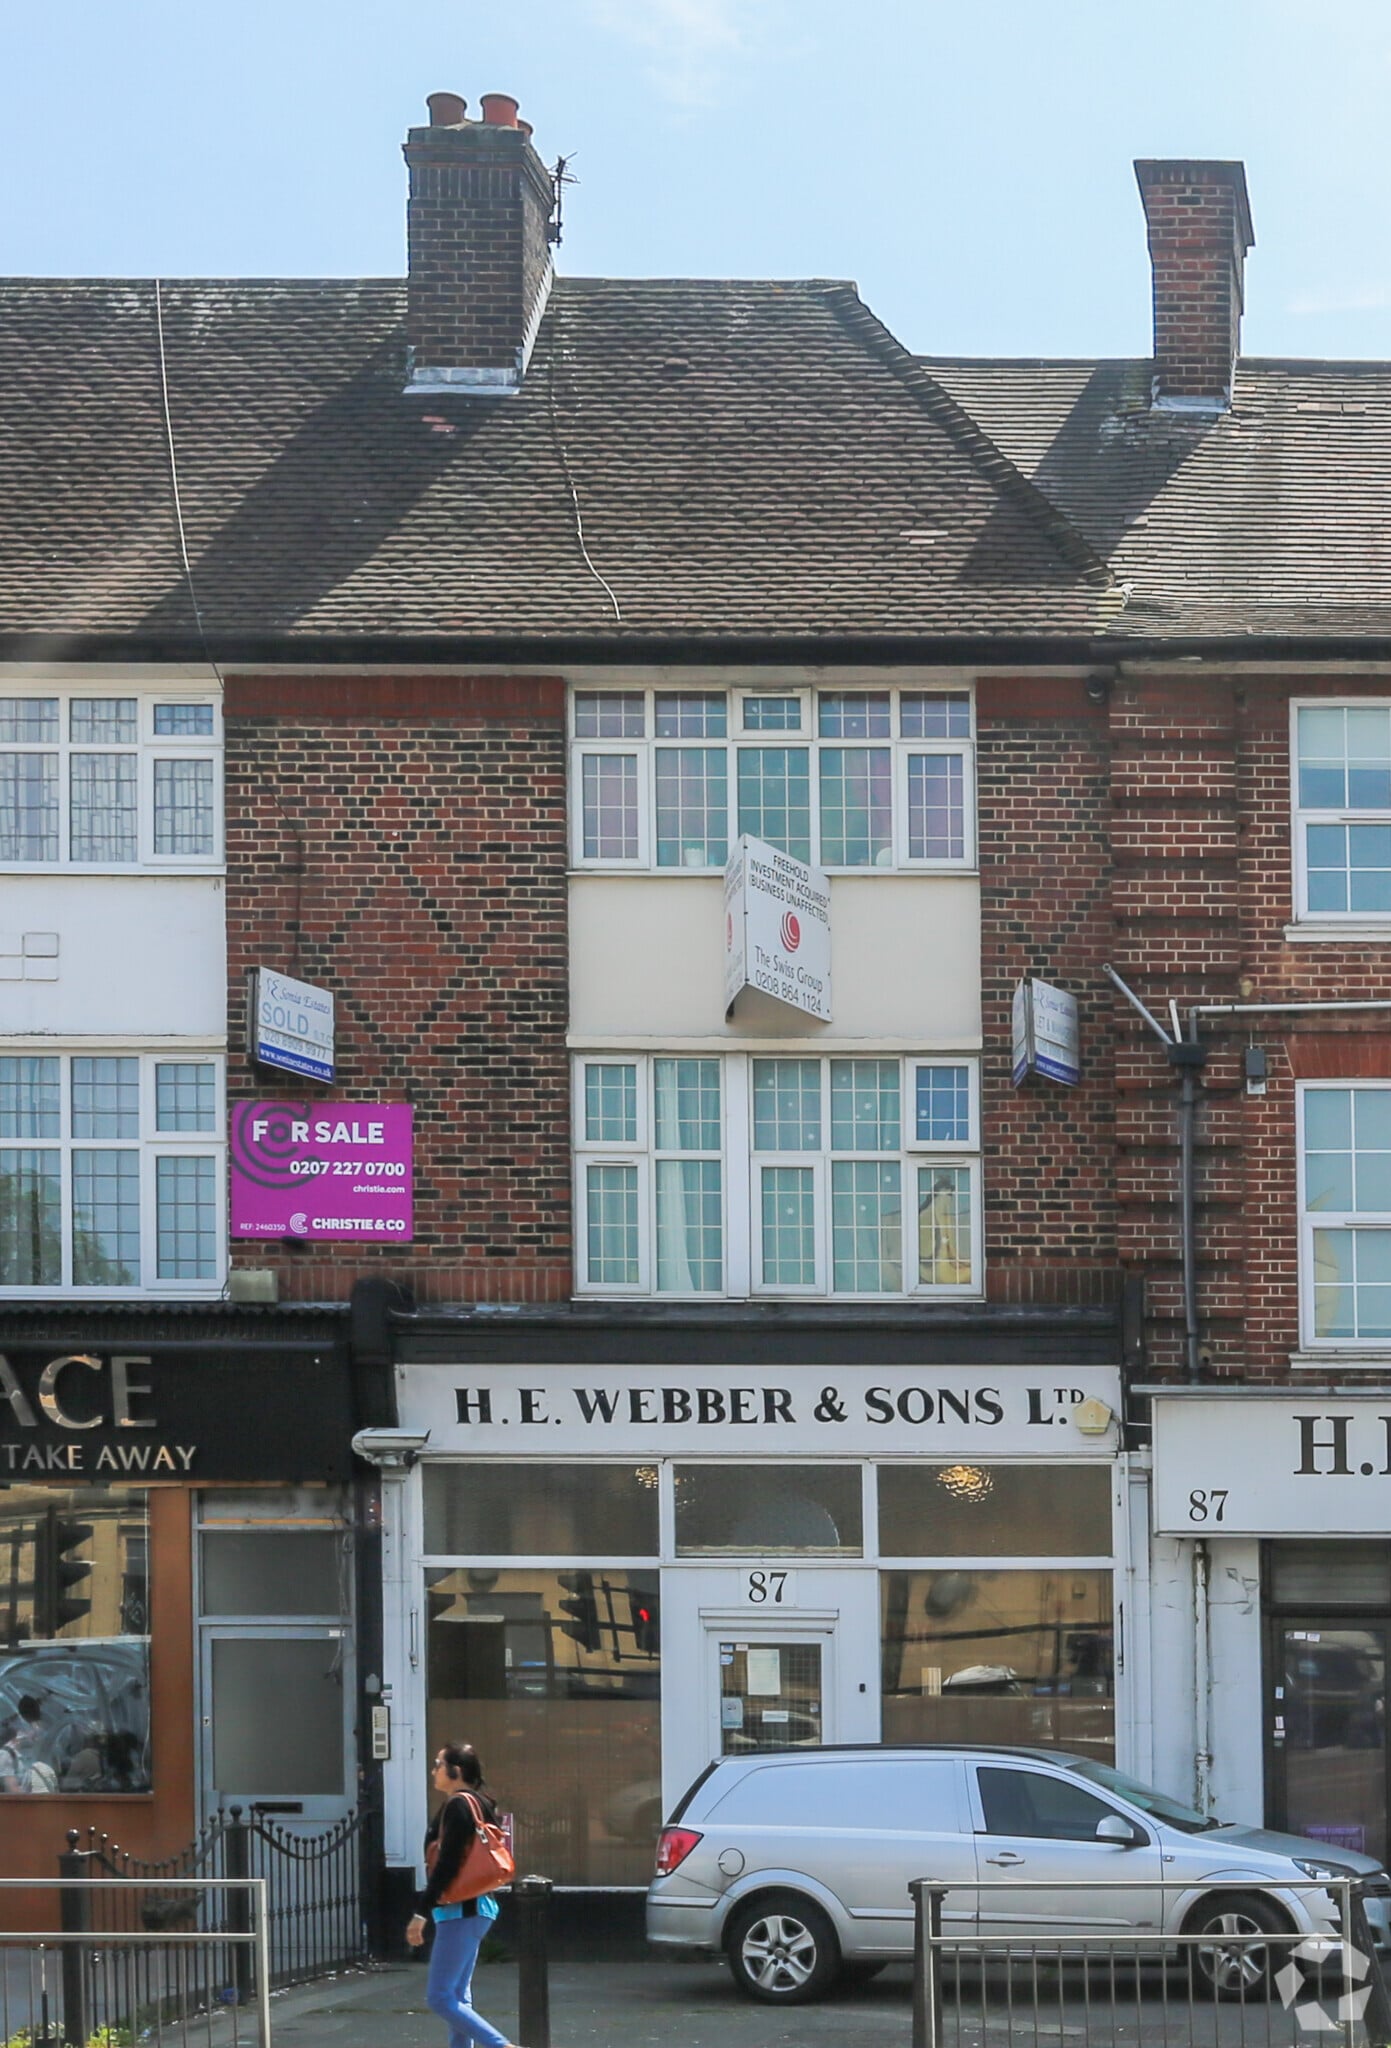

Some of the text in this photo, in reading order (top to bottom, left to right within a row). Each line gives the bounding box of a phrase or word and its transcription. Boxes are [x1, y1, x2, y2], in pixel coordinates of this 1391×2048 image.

[751, 858, 795, 890] INVESTMENT
[796, 882, 828, 909] ACQUIRED
[773, 854, 809, 882] FREEHOLD
[755, 944, 771, 968] The
[773, 954, 795, 979] Swiss
[797, 966, 823, 994] Group
[755, 969, 821, 1014] 0208 864 1124
[262, 1001, 309, 1036] SOLD
[253, 1120, 384, 1144] FOR SALE
[290, 1160, 405, 1177] 0207 227 0700
[353, 1185, 405, 1194] christie.com
[312, 1217, 374, 1232] CHRISTIE
[572, 1387, 797, 1425] WEBBER
[813, 1386, 848, 1424] &
[864, 1387, 1004, 1425] SONS
[2, 1444, 197, 1471] TAKE AWAY
[1189, 1489, 1229, 1522] 87
[748, 1571, 788, 1603] 87
